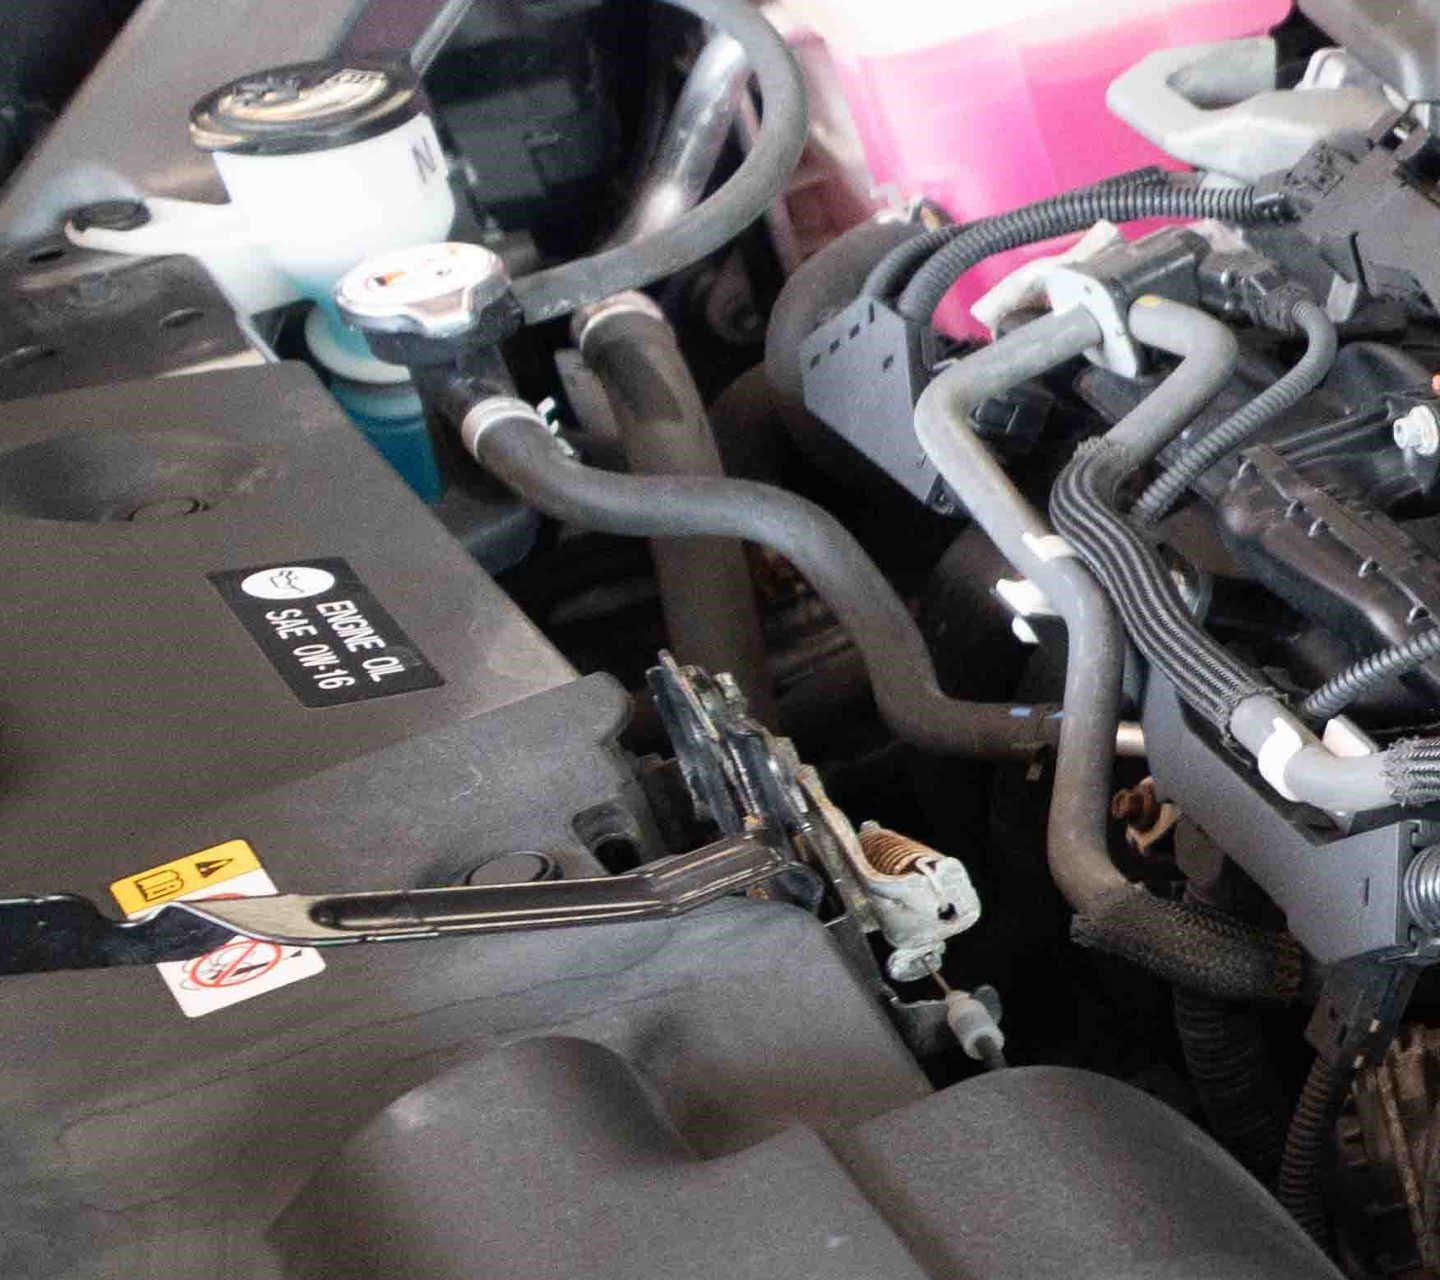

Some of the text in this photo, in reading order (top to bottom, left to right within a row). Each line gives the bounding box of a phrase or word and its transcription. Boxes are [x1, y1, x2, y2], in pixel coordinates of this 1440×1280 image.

[265, 608, 356, 689] SAE 0W-16
[315, 600, 405, 683] ENGINE OIL
